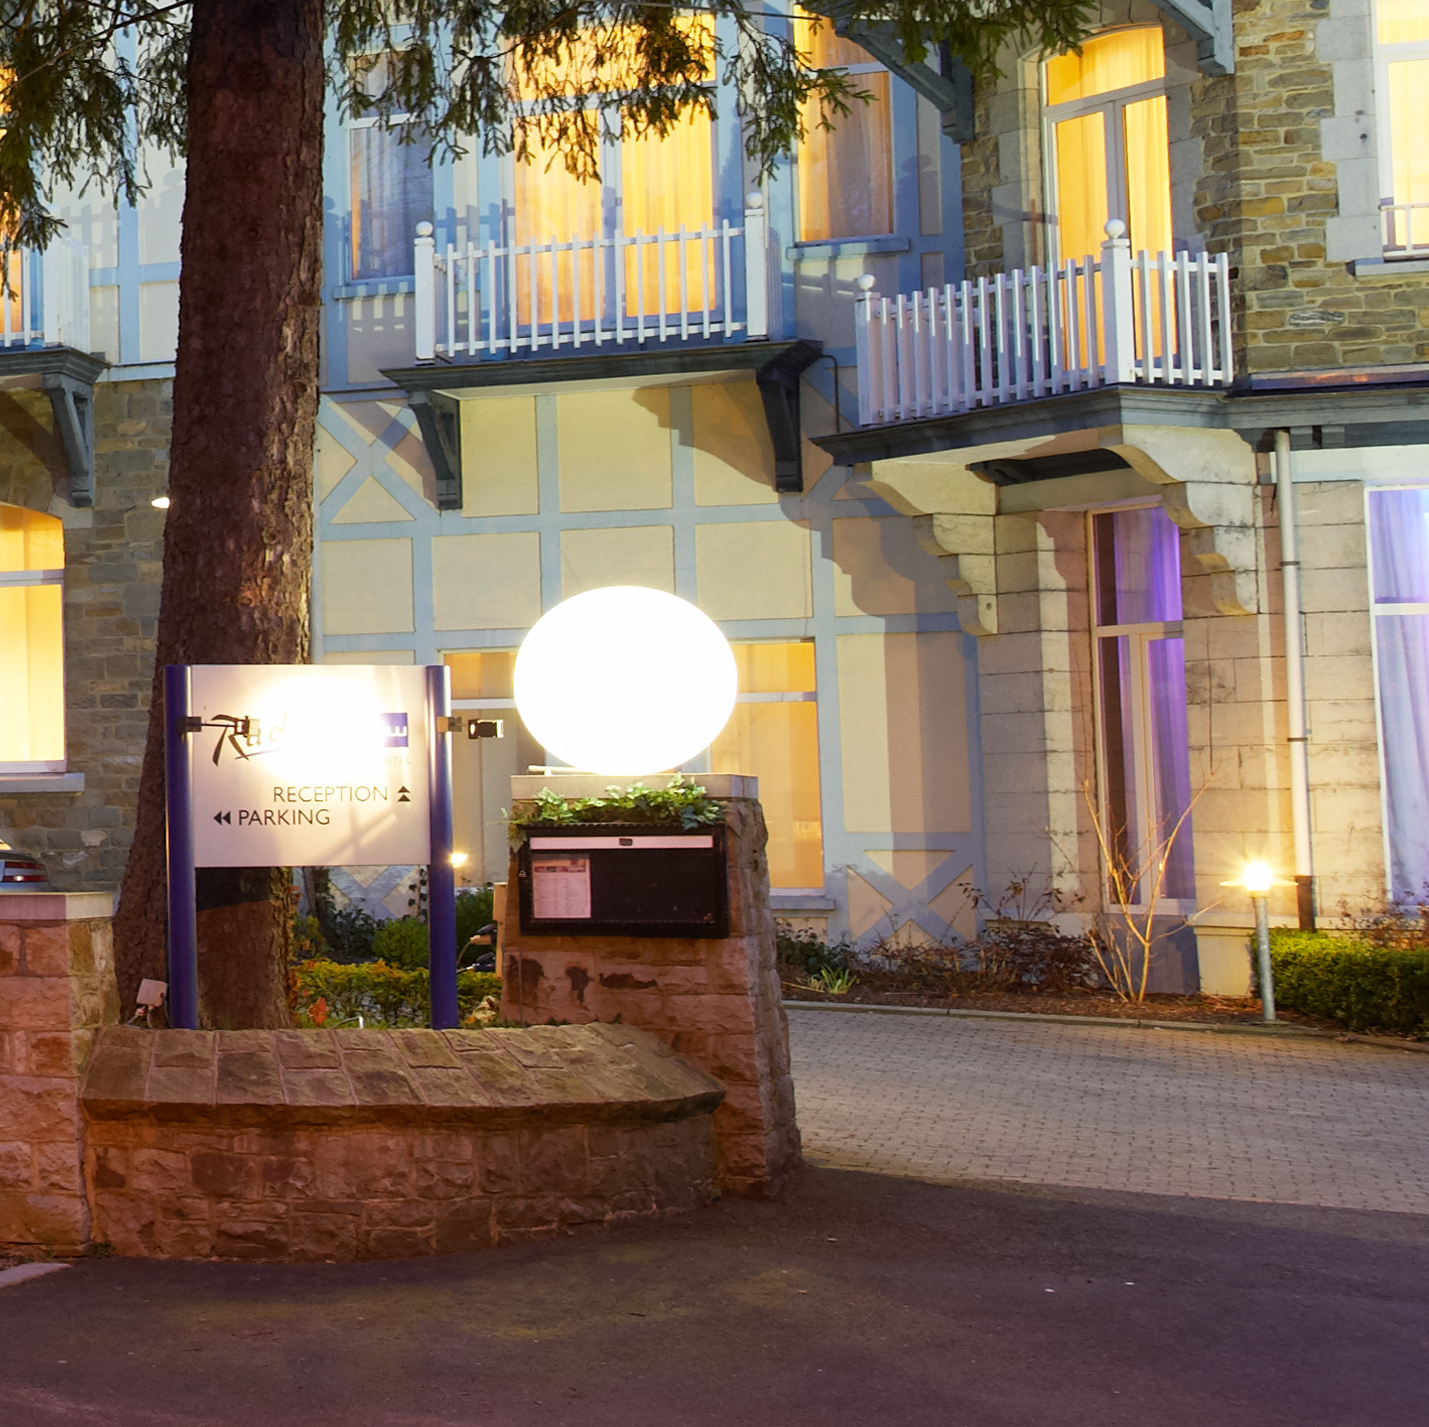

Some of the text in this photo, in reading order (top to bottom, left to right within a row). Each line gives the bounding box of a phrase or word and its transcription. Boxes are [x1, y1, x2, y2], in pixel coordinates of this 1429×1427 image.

[384, 756, 412, 765] OTEL
[273, 785, 388, 803] RECEPTION
[238, 809, 330, 825] PARKING
